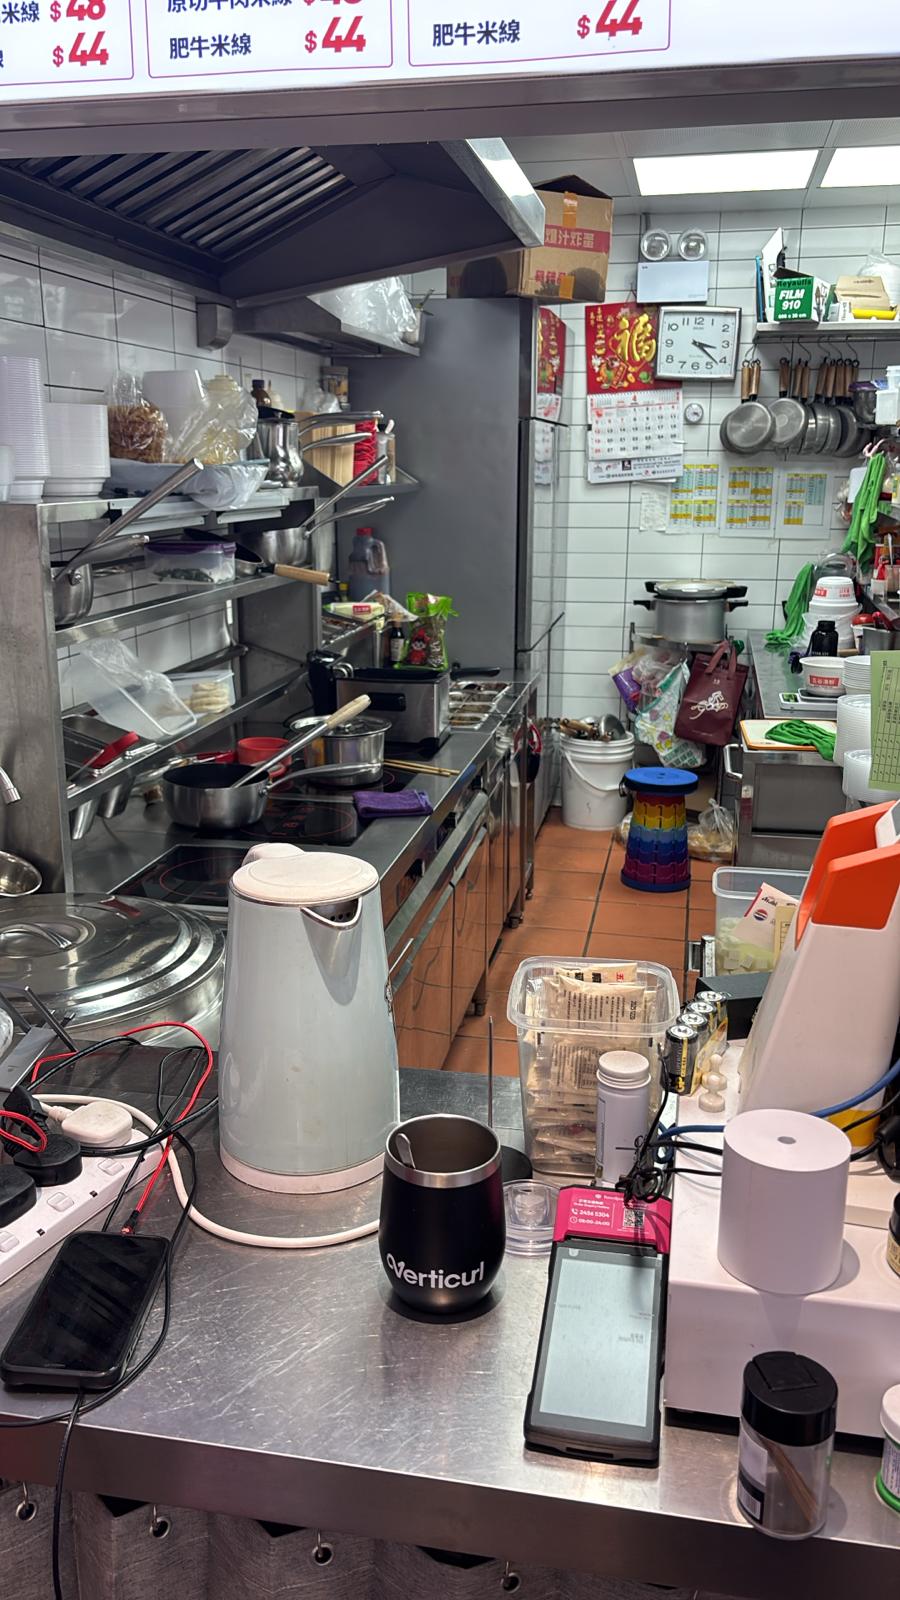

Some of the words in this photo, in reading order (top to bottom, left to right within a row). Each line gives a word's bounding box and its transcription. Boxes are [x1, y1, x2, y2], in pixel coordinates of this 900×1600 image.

[0, 1, 40, 24] 米線
[432, 19, 521, 47] 肥牛米線
[577, 0, 643, 39] $44
[169, 33, 252, 59] 肥牛米線
[304, 16, 366, 53] $44
[52, 31, 109, 67] $44
[779, 289, 805, 299] FILM
[782, 300, 801, 310] 910
[682, 318, 690, 326] 11
[694, 317, 704, 325] 12
[668, 323, 678, 331] 10
[722, 324, 730, 332] 2
[613, 313, 656, 362] 福
[665, 339, 674, 348] 9
[722, 340, 730, 348] 3
[666, 354, 674, 364] 8
[678, 361, 687, 369] 7
[691, 362, 700, 370] 6
[705, 361, 714, 370] 5
[676, 1076, 684, 1092] GP
[386, 1253, 484, 1288] Verticurl
